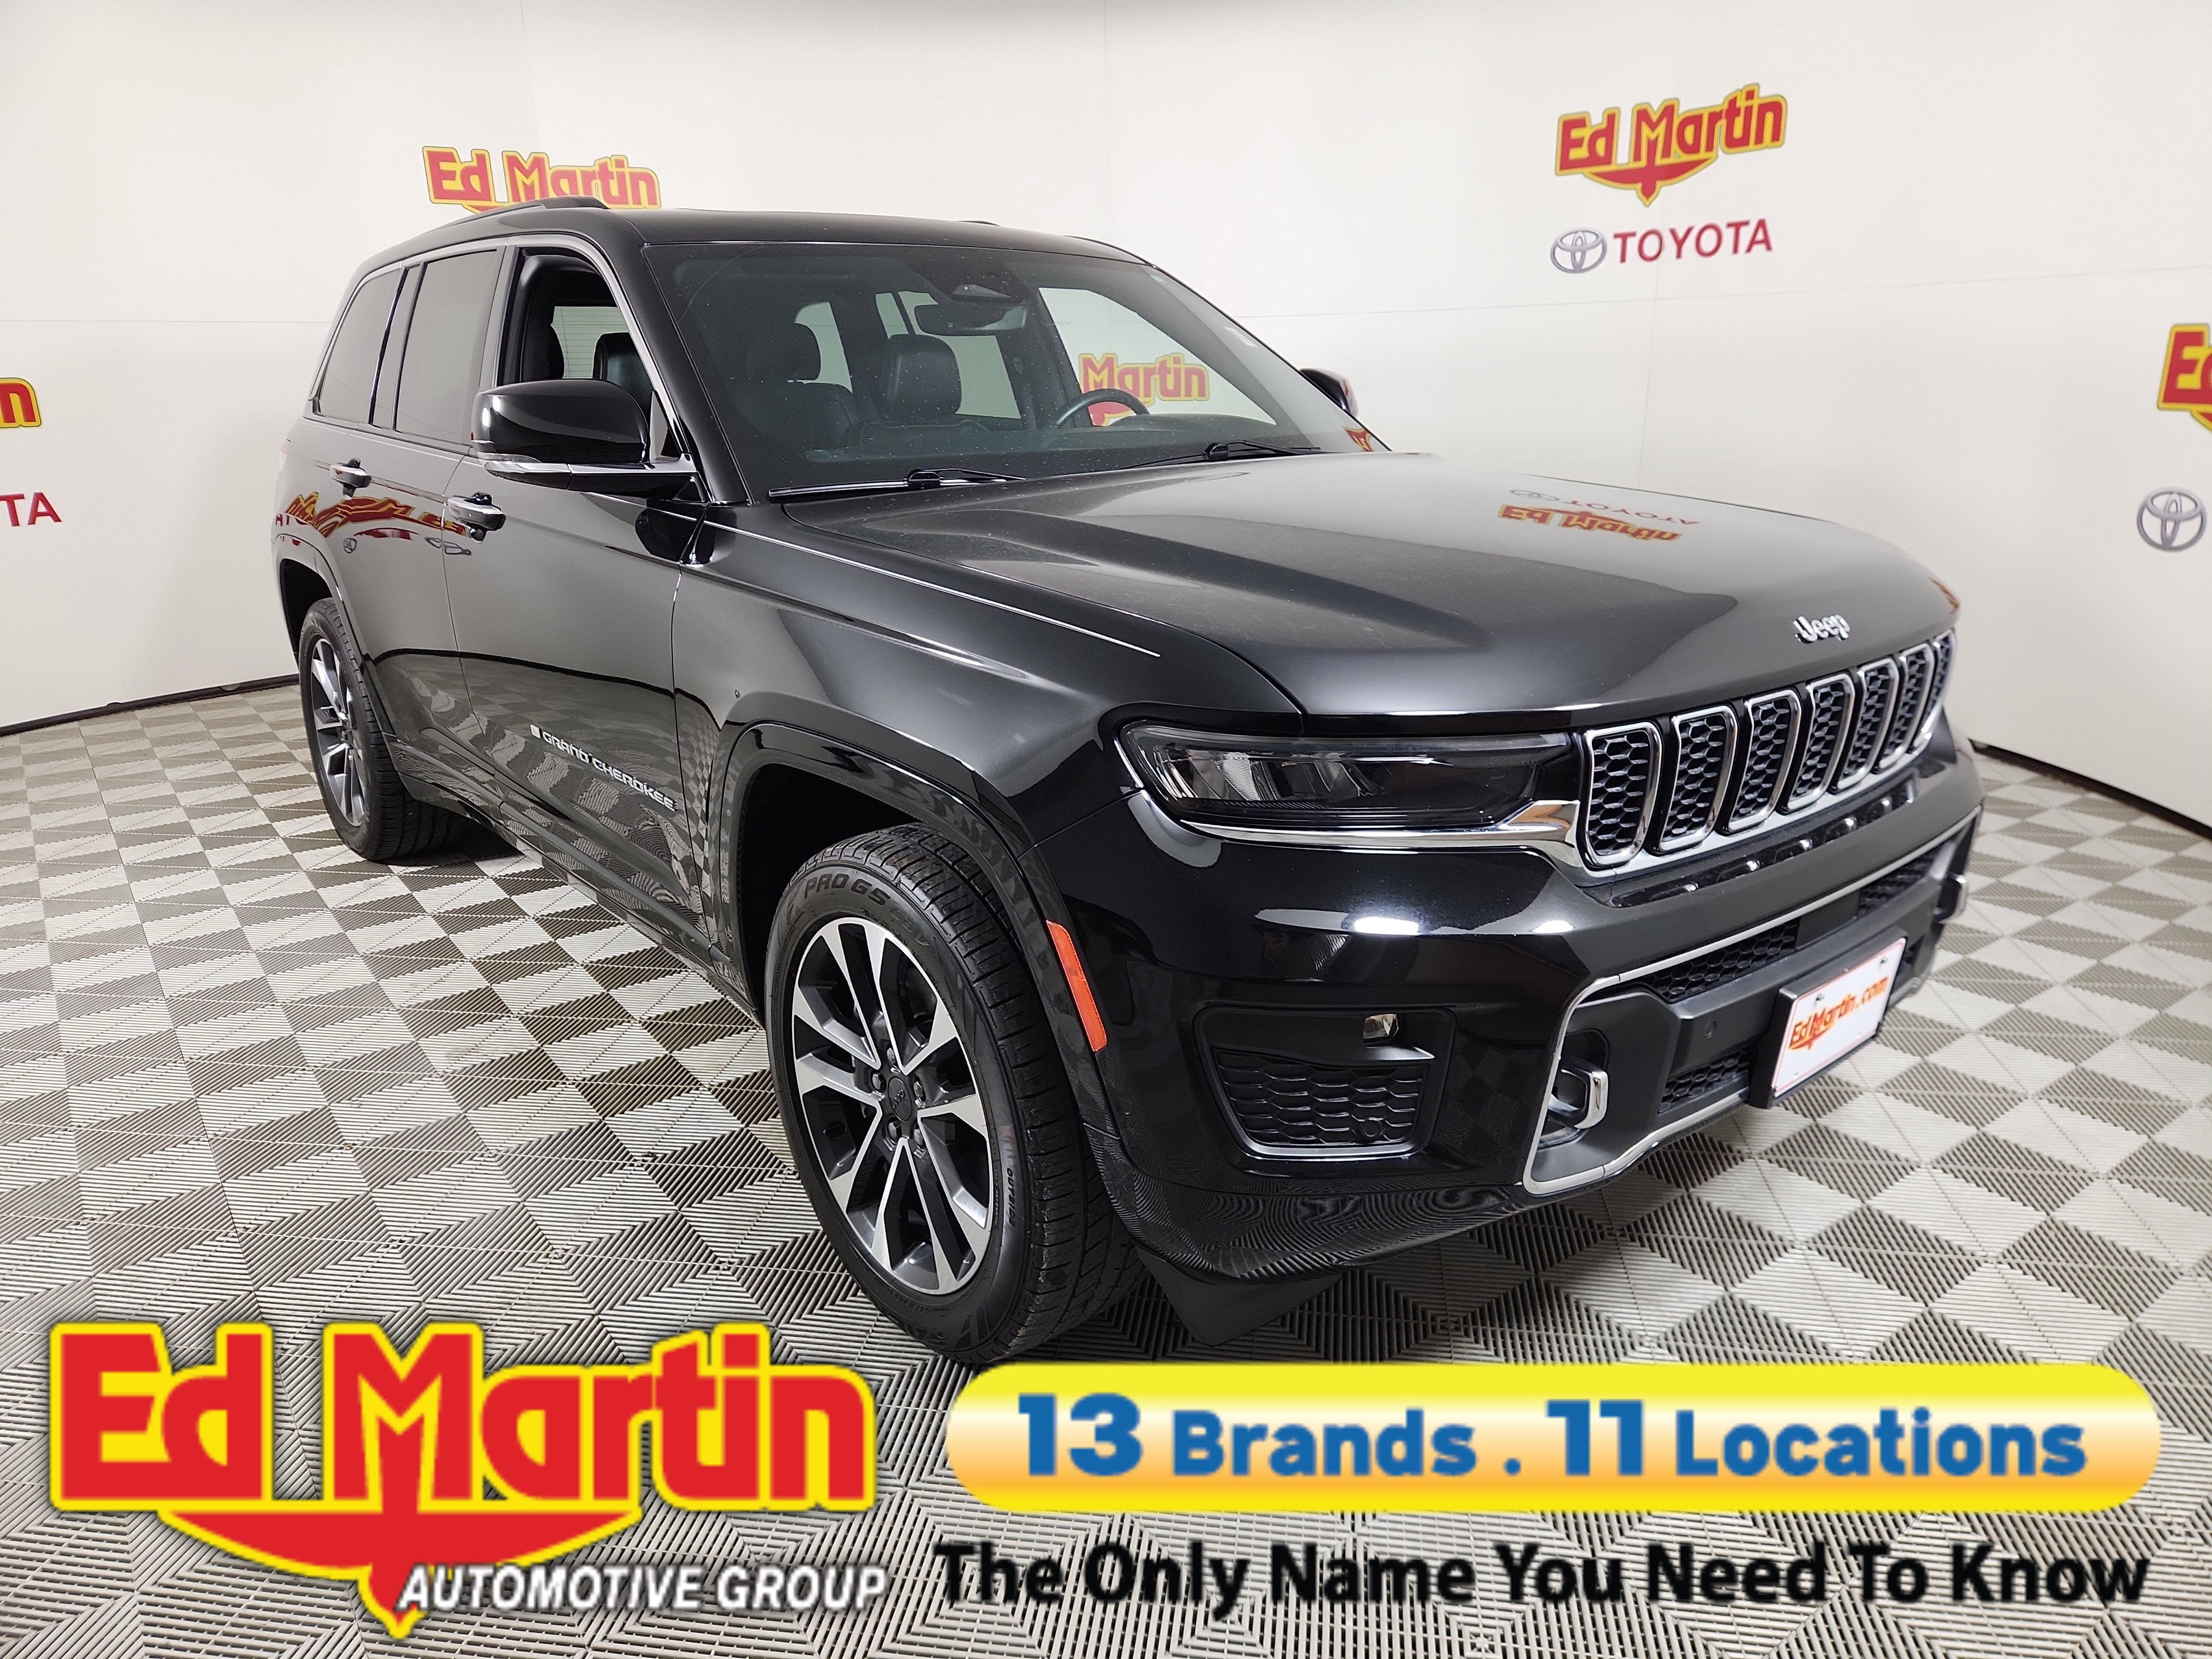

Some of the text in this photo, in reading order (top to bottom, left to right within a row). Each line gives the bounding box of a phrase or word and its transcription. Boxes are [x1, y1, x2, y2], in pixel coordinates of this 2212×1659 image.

[1556, 84, 1785, 173] Ed Martin
[424, 147, 659, 208] Ed Martin
[1612, 218, 1773, 263] TOYOTA
[1080, 354, 1208, 401] Martin
[1793, 614, 1850, 642] Jeep
[542, 731, 677, 812] GRAND CHEROKEE
[805, 873, 850, 899] PRO
